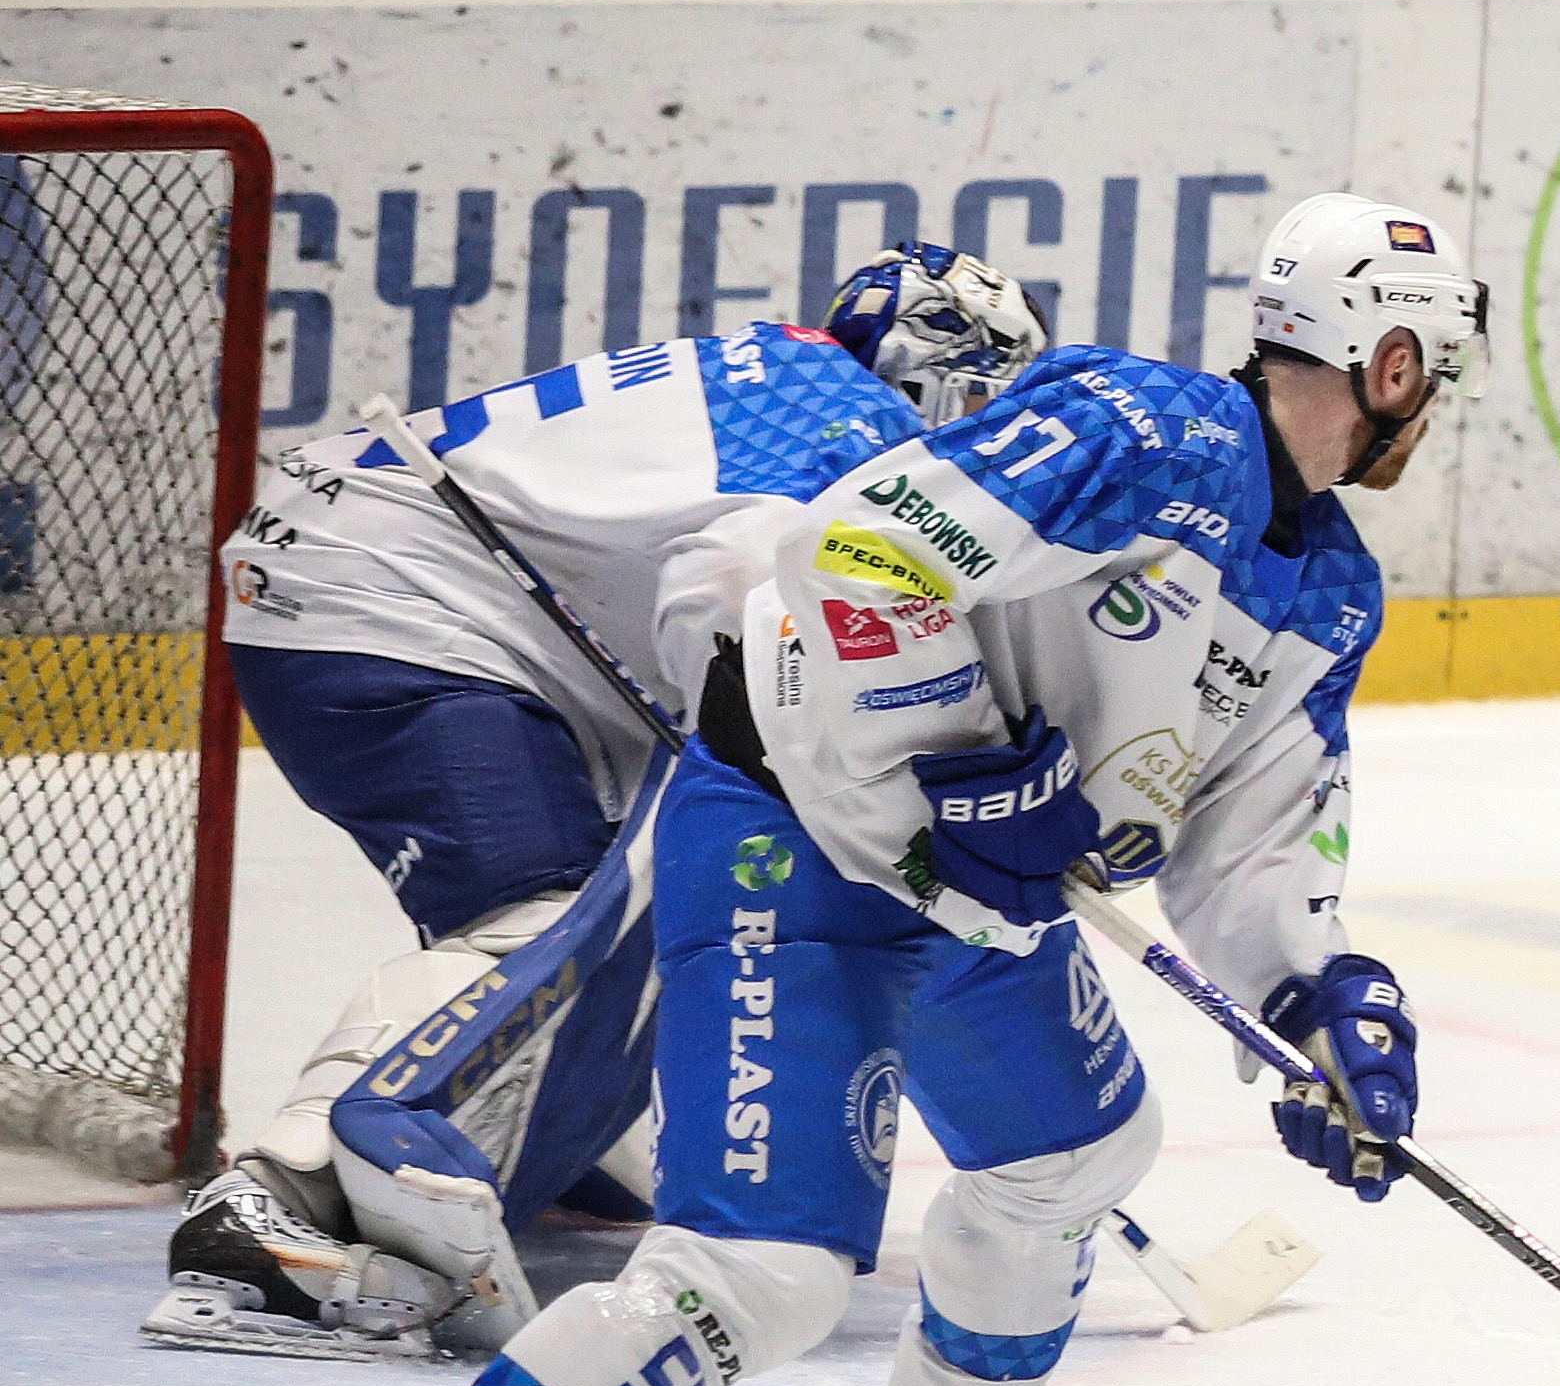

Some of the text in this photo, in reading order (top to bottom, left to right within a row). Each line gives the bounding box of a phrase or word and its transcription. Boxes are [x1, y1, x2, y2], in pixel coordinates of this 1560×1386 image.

[1270, 258, 1298, 277] 57
[1386, 291, 1434, 305] CCM
[908, 609, 955, 639] LIGA
[940, 741, 1079, 822] BAUE
[369, 970, 508, 1097] CCM
